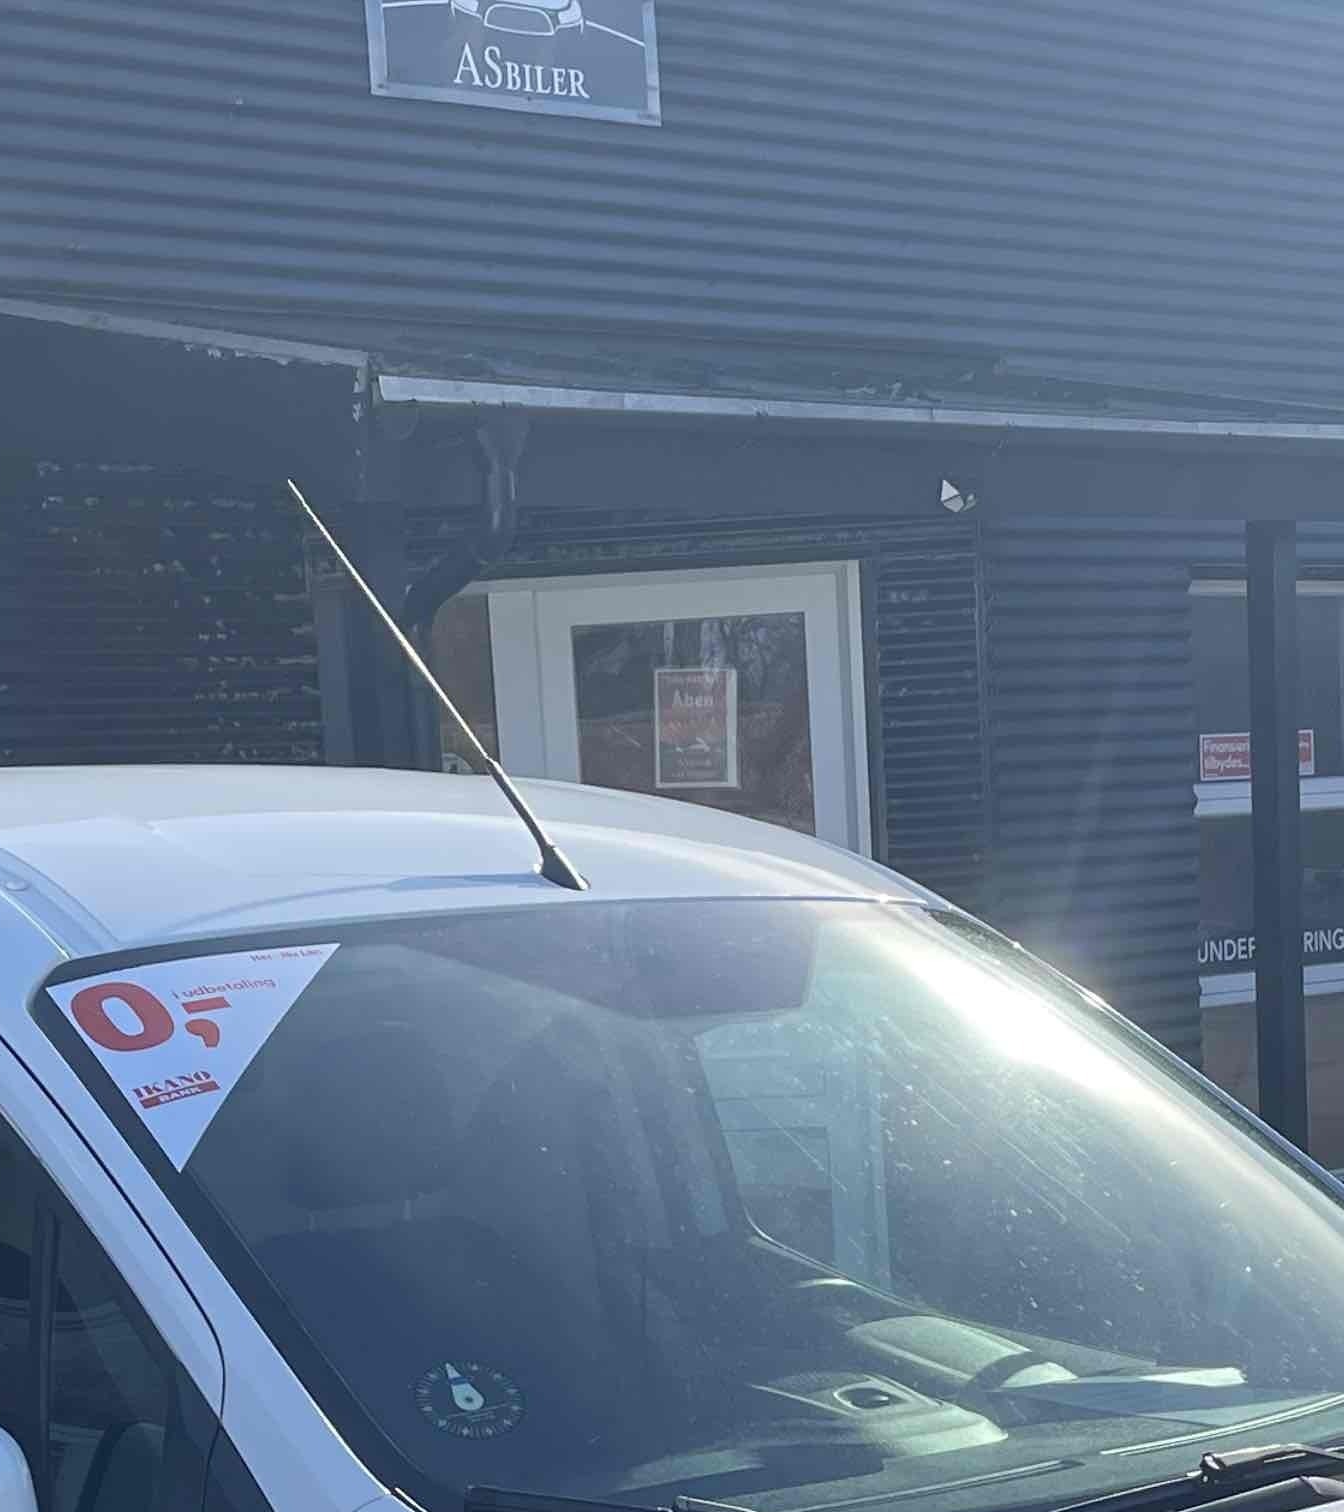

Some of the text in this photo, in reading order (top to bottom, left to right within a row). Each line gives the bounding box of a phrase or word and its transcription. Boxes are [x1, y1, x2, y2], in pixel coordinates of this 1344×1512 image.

[181, 977, 276, 999] udbetaling
[132, 1070, 212, 1099] IKANO
[159, 1085, 203, 1103] BANK
